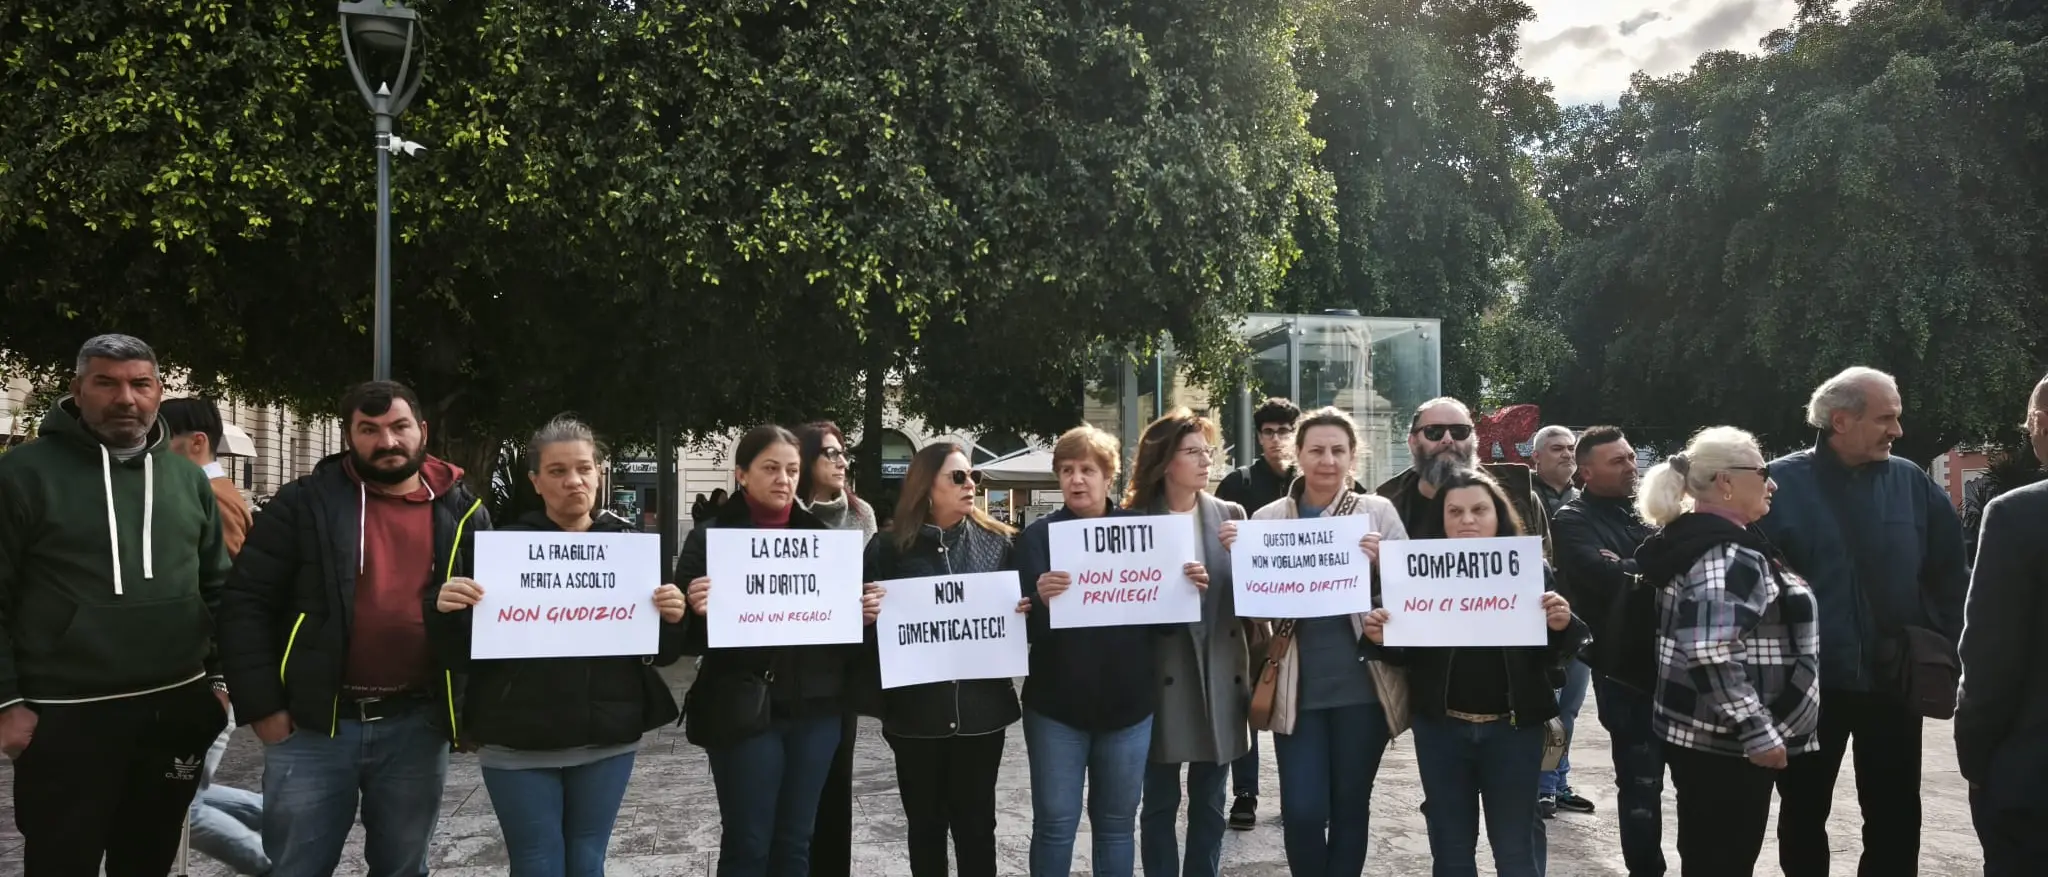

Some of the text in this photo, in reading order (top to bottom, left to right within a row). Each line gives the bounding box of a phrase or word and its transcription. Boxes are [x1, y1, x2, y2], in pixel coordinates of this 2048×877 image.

[752, 534, 820, 558] LA CASA È
[1083, 525, 1153, 554] I DIRITTI
[1263, 530, 1334, 548] QUESTO NATALE
[529, 544, 609, 562] LA FRAGILITA'
[1252, 551, 1350, 570] NON VOGLIAMO REGALI
[1407, 549, 1520, 579] COMPARTO 6
[521, 572, 615, 589] MERITA ASCOLTO
[746, 573, 821, 598] UN DIRITTO,
[1078, 566, 1162, 586] NON SONO
[1246, 575, 1359, 594] VOGLIAMO DIRITTI!
[934, 580, 965, 606] NON
[1083, 586, 1159, 606] PRIVILEGI!
[1404, 594, 1517, 612] NOI CI SIAMO!
[498, 603, 637, 624] NON GIUDIZIO!
[738, 609, 832, 624] NON UN REGALO!
[898, 616, 1006, 646] DIMENTICATECI!
